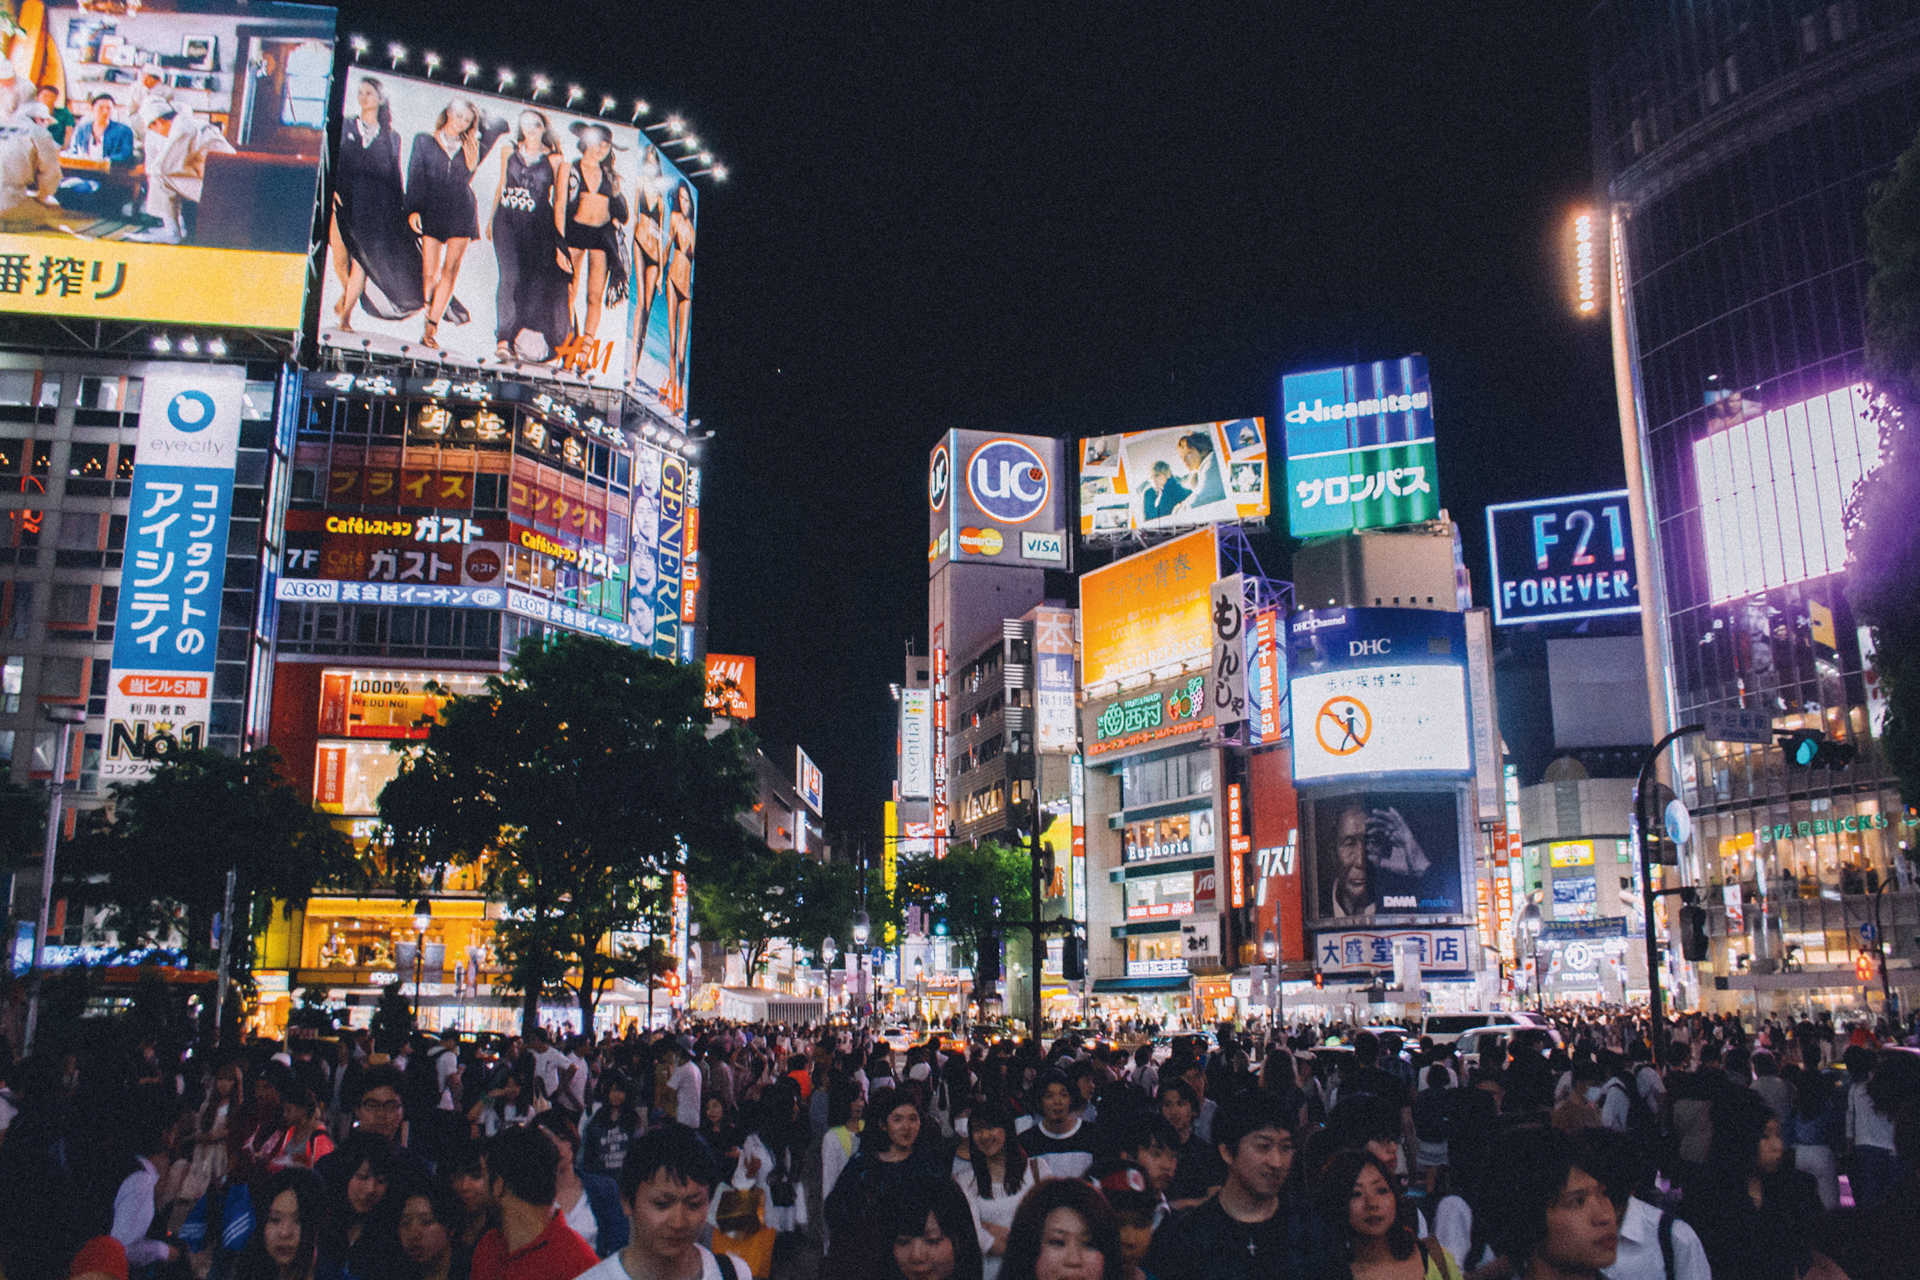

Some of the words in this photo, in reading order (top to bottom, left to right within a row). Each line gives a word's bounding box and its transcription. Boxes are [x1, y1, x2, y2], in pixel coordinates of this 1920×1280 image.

[0, 253, 127, 300] 番搾り
[1285, 391, 1428, 425] Hisamitsu
[977, 458, 1043, 502] UC
[1296, 466, 1431, 508] サロンパス
[511, 481, 603, 534] コンタクト
[414, 516, 484, 544] ガスト
[1027, 539, 1060, 553] VISA
[1533, 505, 1626, 571] F21
[131, 482, 183, 654] アイシティ
[175, 483, 220, 655] コンタクトの
[286, 549, 320, 569] 7F
[368, 550, 453, 582] ガスト
[282, 581, 332, 598] AEON
[342, 583, 469, 604] 英会話イーオン
[1503, 570, 1630, 609] FOREVER
[1349, 638, 1392, 657] DHC
[353, 679, 409, 695] 1000%
[1759, 812, 1888, 843] STARBUCKS
[1128, 839, 1189, 861] Euphoria
[1256, 828, 1297, 906] クスリ
